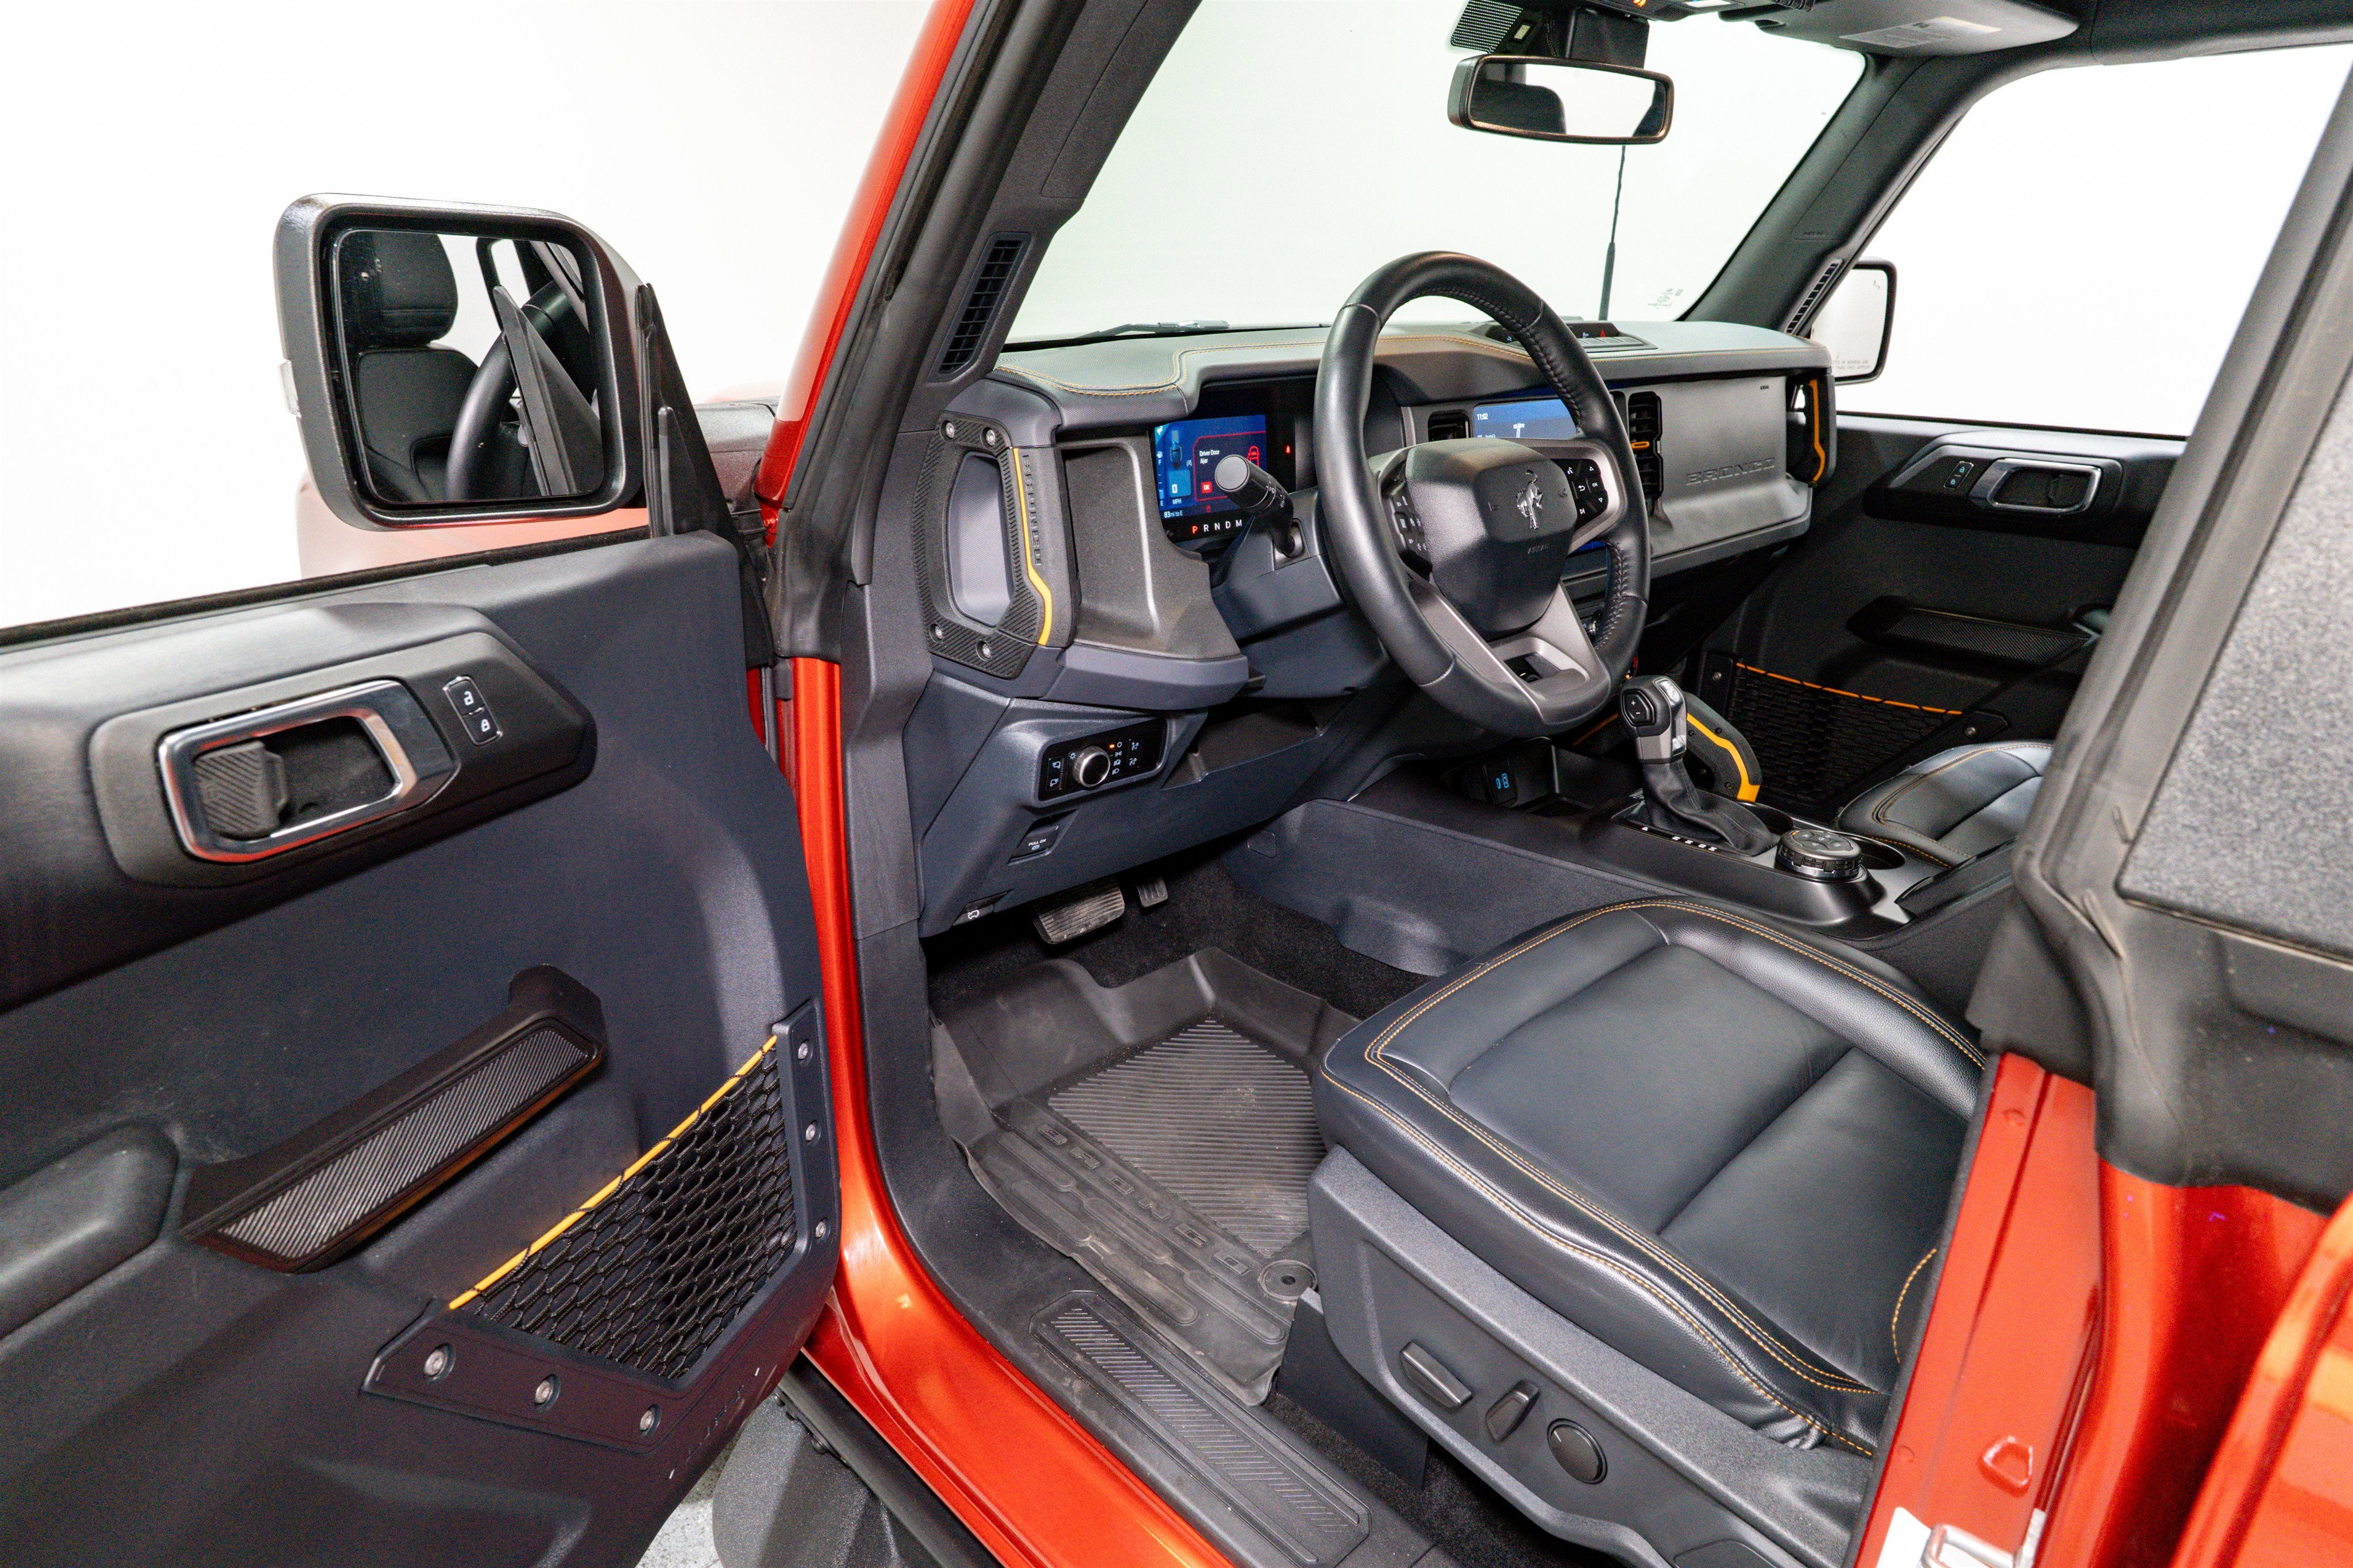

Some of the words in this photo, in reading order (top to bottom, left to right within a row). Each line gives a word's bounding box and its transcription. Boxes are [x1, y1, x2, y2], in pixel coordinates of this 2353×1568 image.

[1685, 457, 1775, 486] BRONCO
[1172, 484, 1178, 494] 0
[1192, 526, 1198, 534] P
[1225, 521, 1231, 529] D
[1037, 1124, 1249, 1275] BRONCO
